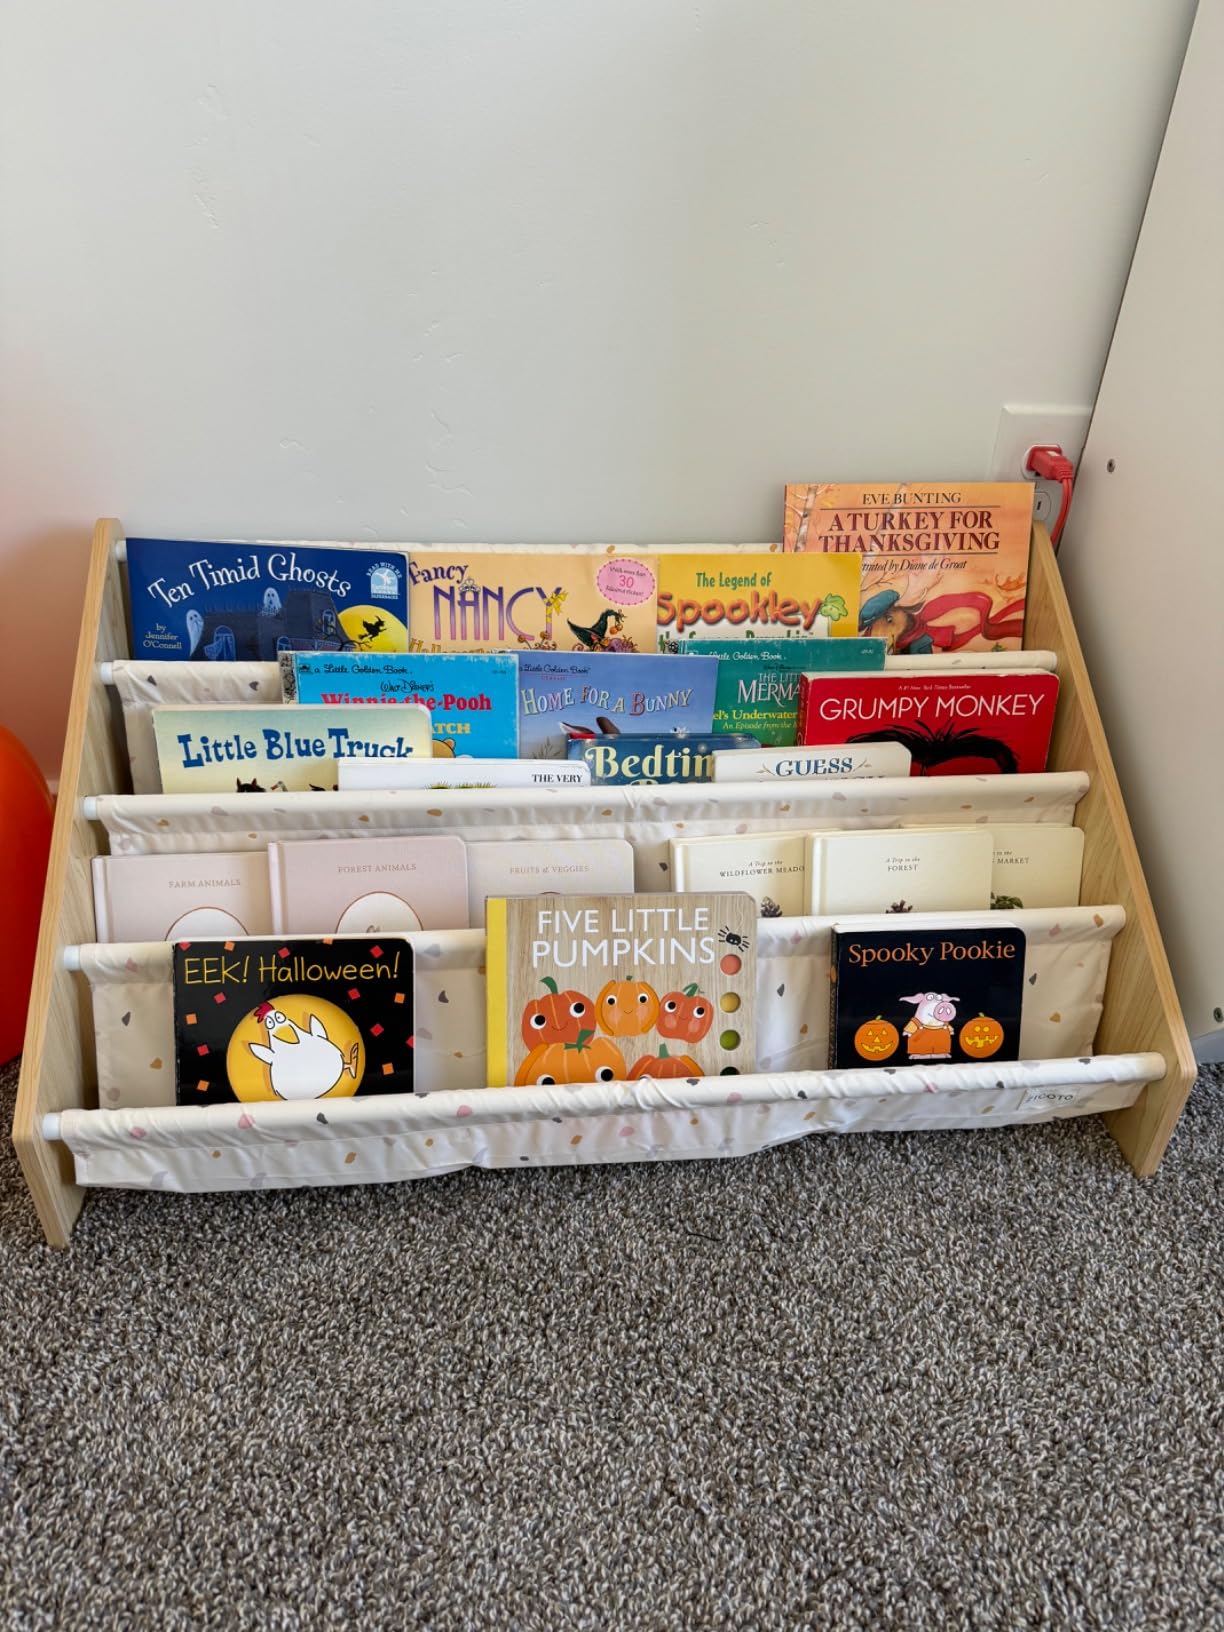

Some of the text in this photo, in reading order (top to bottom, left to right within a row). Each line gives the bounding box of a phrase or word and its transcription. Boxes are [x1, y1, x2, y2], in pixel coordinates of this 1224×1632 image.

[863, 492, 962, 505] EVE BUNTING
[829, 510, 993, 532] A TURKEY FOR
[818, 532, 1000, 553] THANKSGIVING
[408, 561, 469, 585] Fancy
[888, 559, 899, 573] by
[900, 558, 928, 570] Diane
[928, 558, 939, 570] de
[147, 553, 351, 608] Ten Timid Ghosts
[619, 574, 634, 588] 30
[696, 572, 773, 590] The Legend of
[433, 586, 563, 640] NANCY
[657, 590, 823, 633] Spookley
[145, 623, 179, 641] by Jennifer
[143, 640, 182, 649] O'Connell
[732, 651, 760, 661] Golden
[324, 663, 349, 674] Little
[351, 664, 382, 674] Golden
[543, 663, 568, 673] Golden
[759, 671, 801, 682] THE LITT
[520, 685, 693, 716] HOME FOR A BUNNY
[737, 679, 800, 708] MERMA
[712, 709, 798, 720] el's Underwater
[819, 693, 1045, 721] GRUMPY MONKEY
[431, 723, 471, 735] ATCH
[723, 721, 734, 729] An
[177, 727, 413, 768] Little Blue Truck
[585, 744, 713, 779] Bedtim
[775, 757, 853, 777] GUESS
[531, 774, 583, 783] THE VERY
[337, 863, 417, 873] FOREST ANIMALS
[887, 863, 918, 872] FOREST
[997, 856, 1030, 865] MARKET
[510, 864, 590, 874] FRUITS & VEGGIES
[719, 864, 805, 878] WILDFLOWER MEADO
[168, 878, 241, 889] FARM ANIMALS
[538, 907, 710, 934] FIVE LITTLE
[532, 936, 716, 969] PUMPKINS
[848, 940, 1016, 967] Spooky Pookie
[184, 951, 401, 985] EEK! Halloween!
